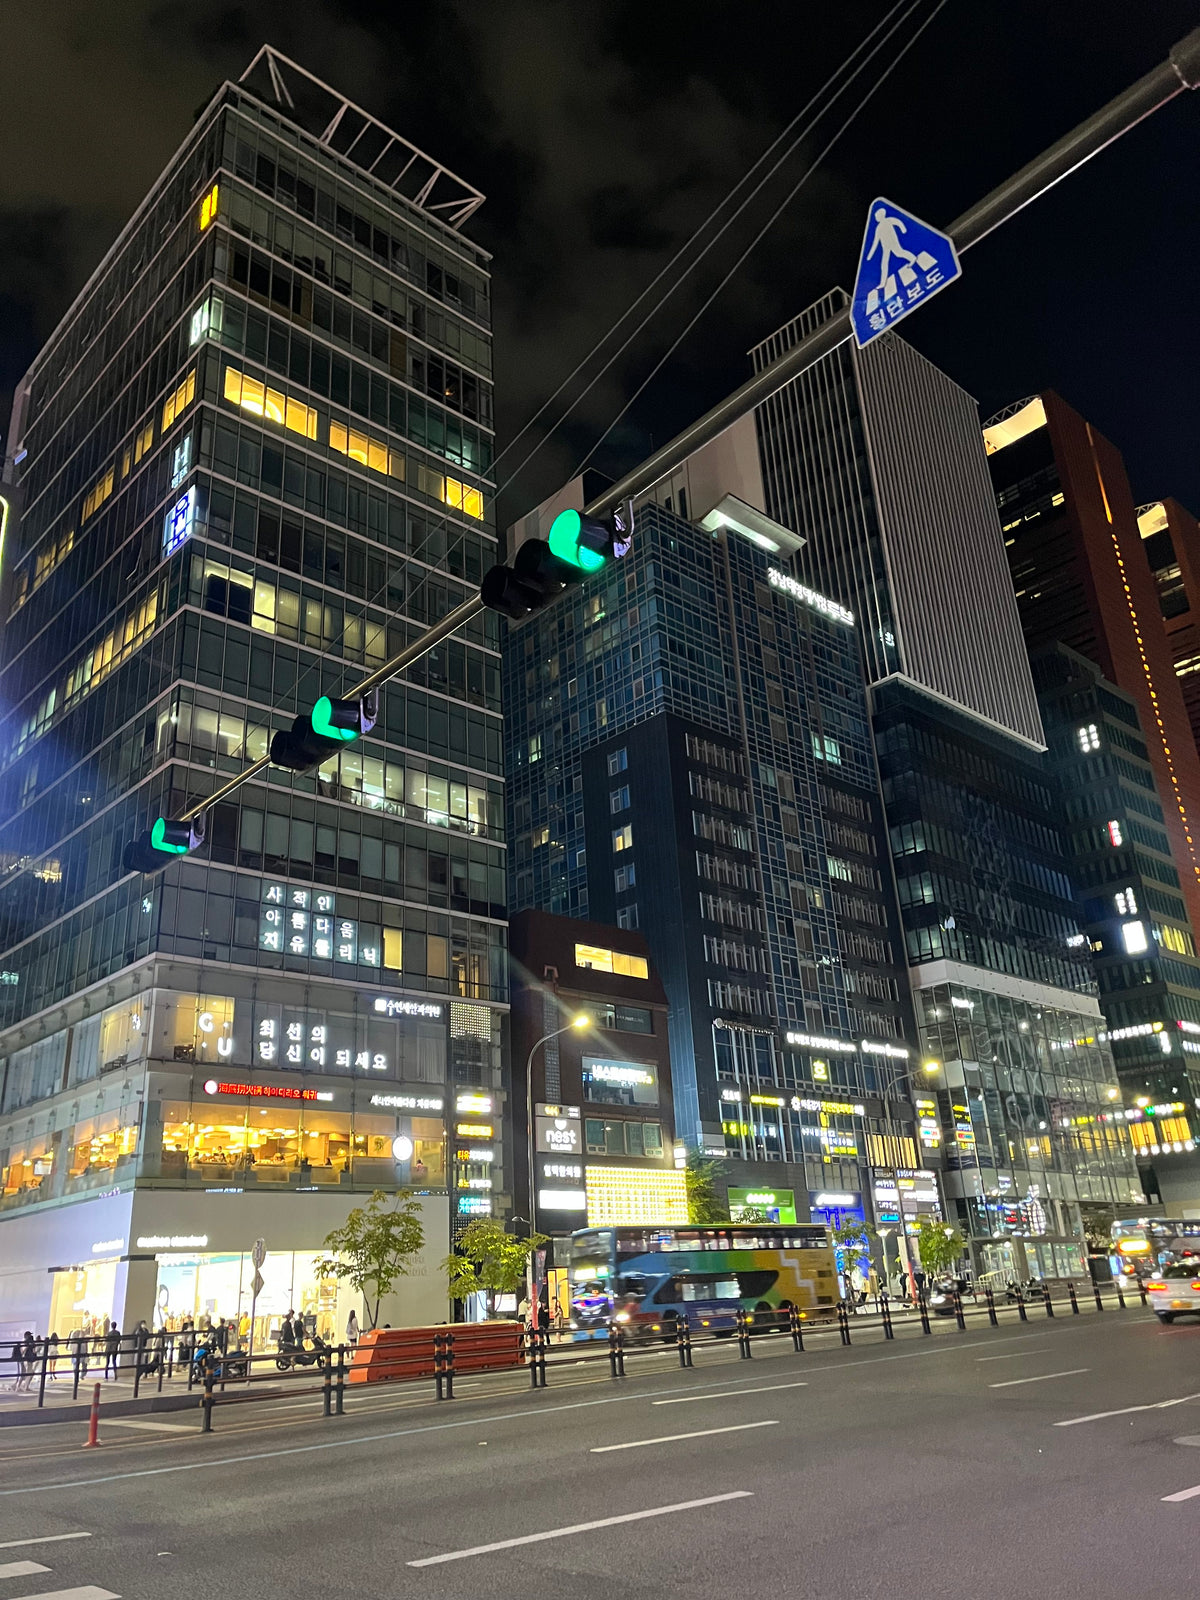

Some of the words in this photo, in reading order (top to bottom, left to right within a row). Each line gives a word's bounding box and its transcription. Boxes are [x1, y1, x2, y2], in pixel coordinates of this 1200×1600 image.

[868, 267, 945, 331] 횡단보도
[266, 886, 331, 911] 사적인
[265, 909, 354, 939] 아름다움
[259, 1019, 327, 1044] 최선의
[259, 1041, 326, 1066] 당신이
[335, 1049, 387, 1070] 되세요
[546, 1129, 577, 1144] nest
